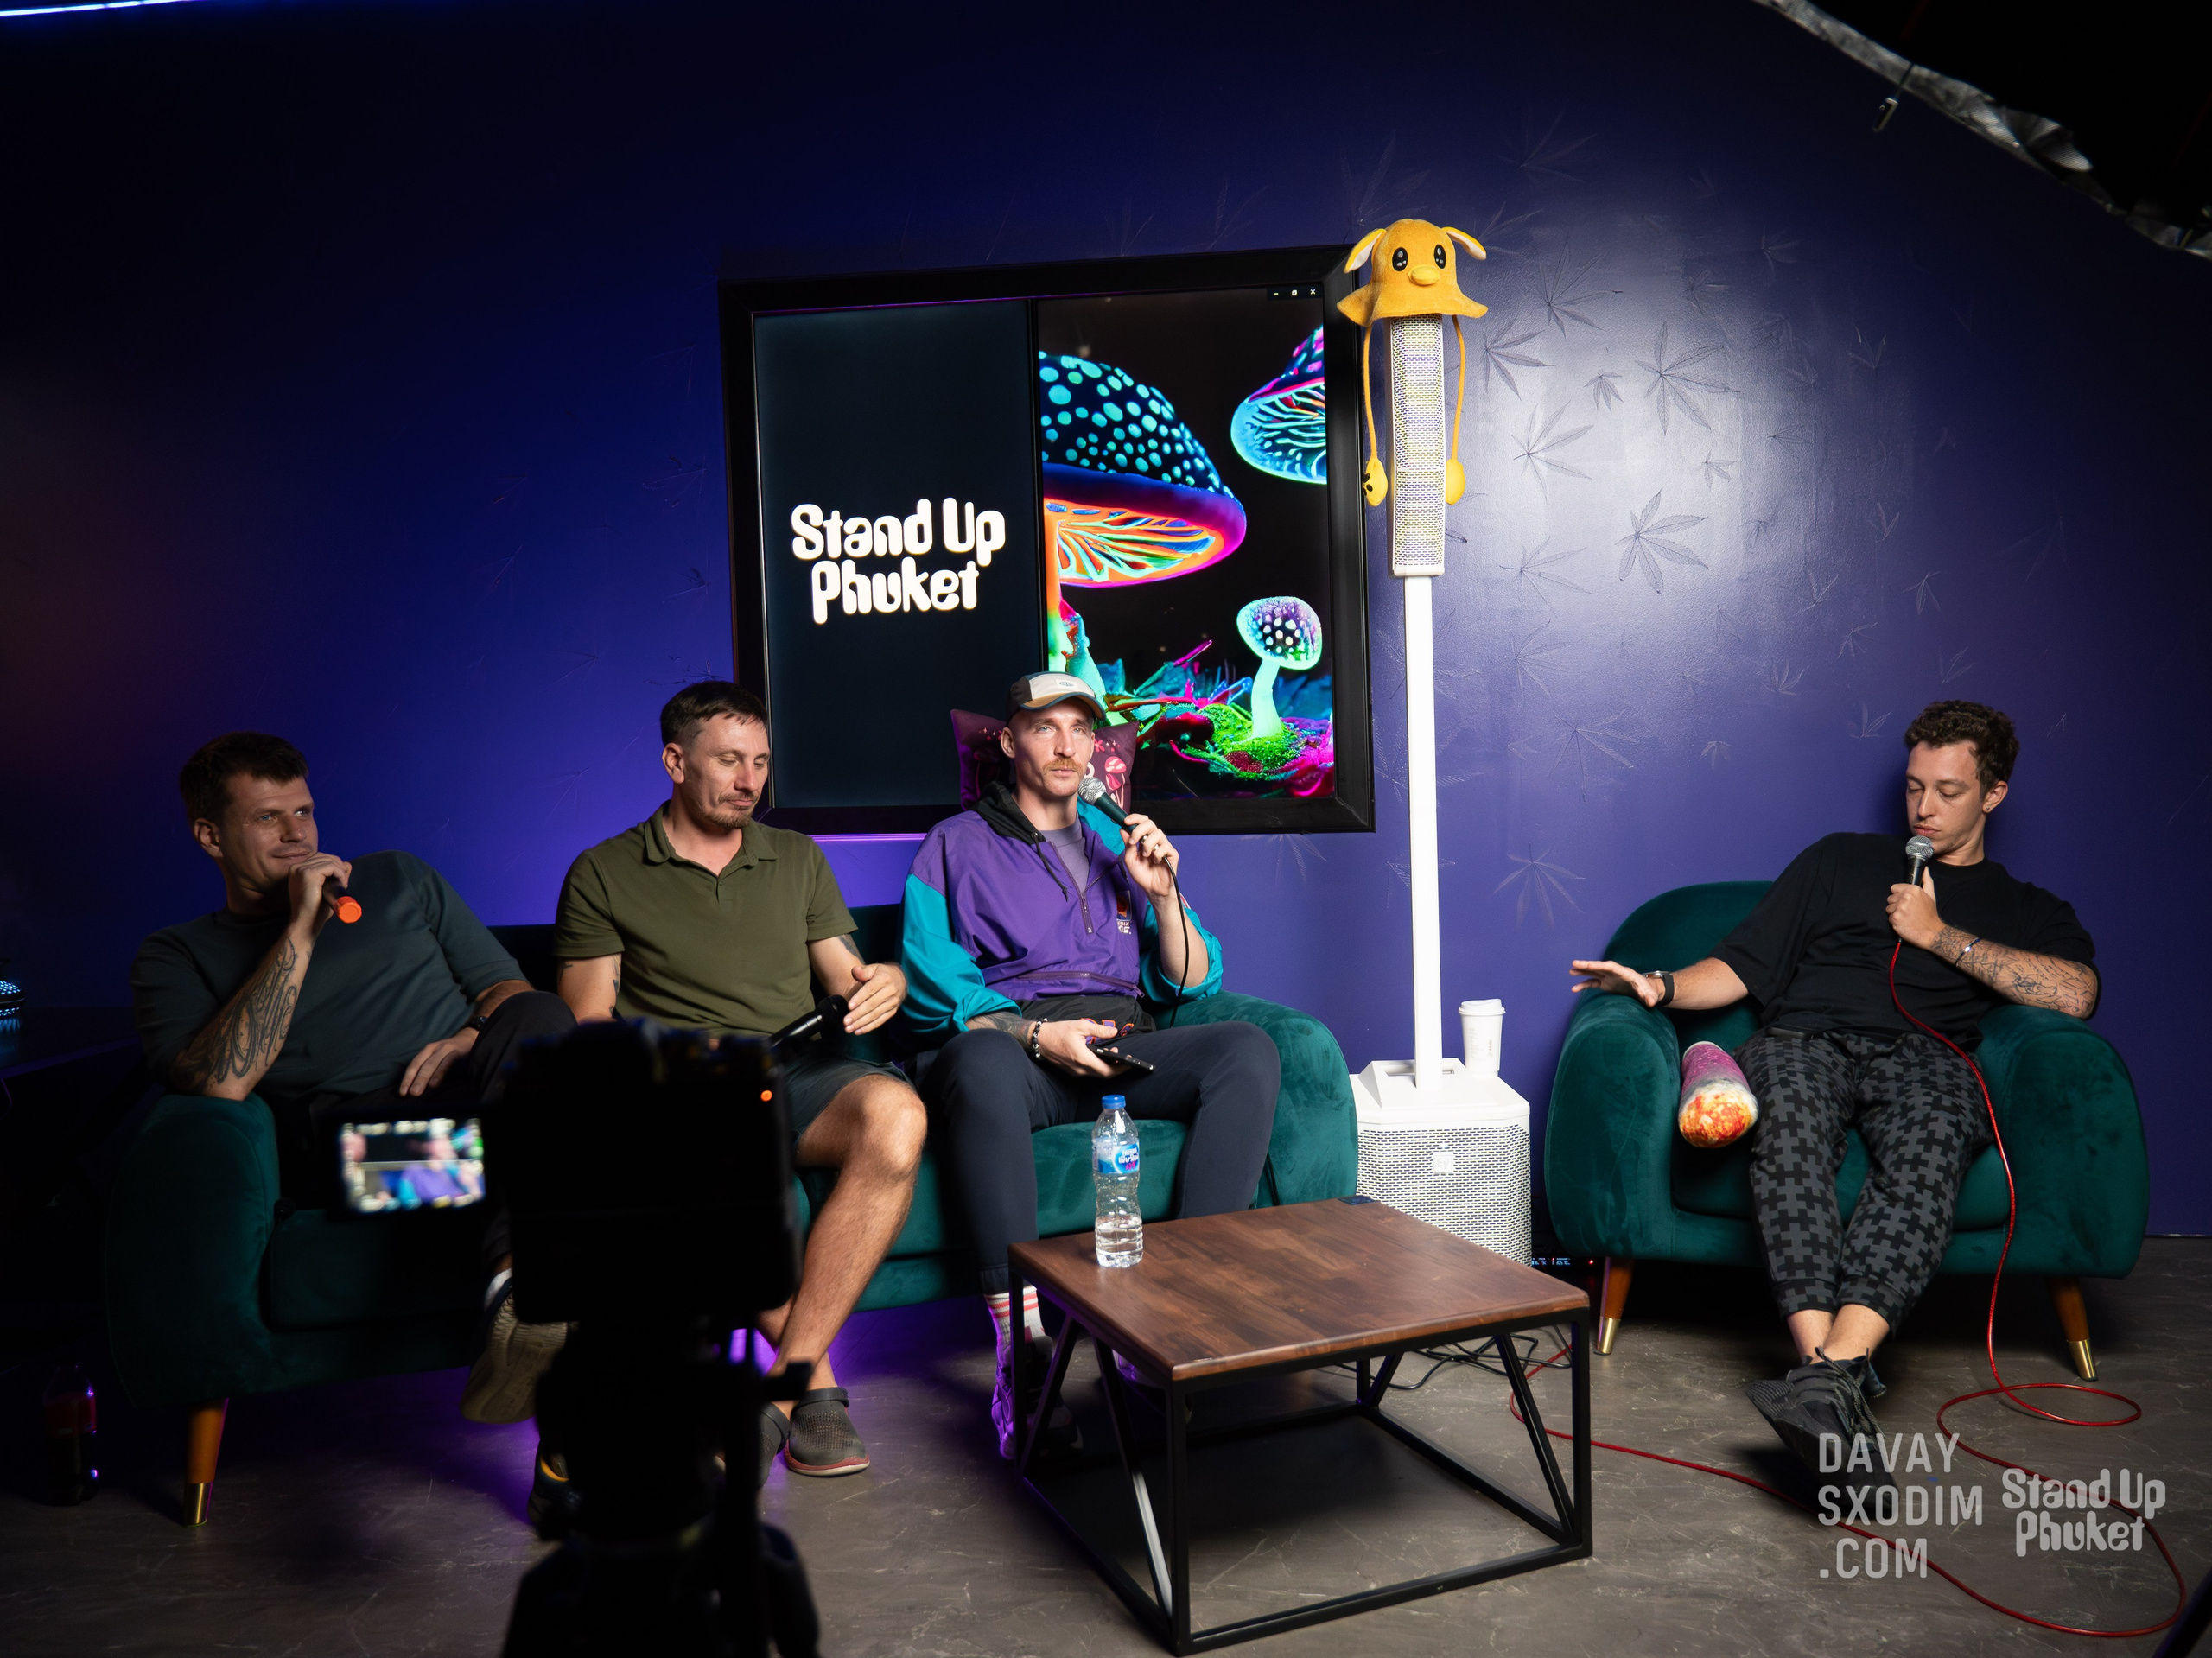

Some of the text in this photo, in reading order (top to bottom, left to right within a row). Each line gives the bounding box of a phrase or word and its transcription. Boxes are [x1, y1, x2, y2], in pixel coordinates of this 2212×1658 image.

[791, 497, 1006, 567] Stand Up
[811, 556, 980, 625] Phuket
